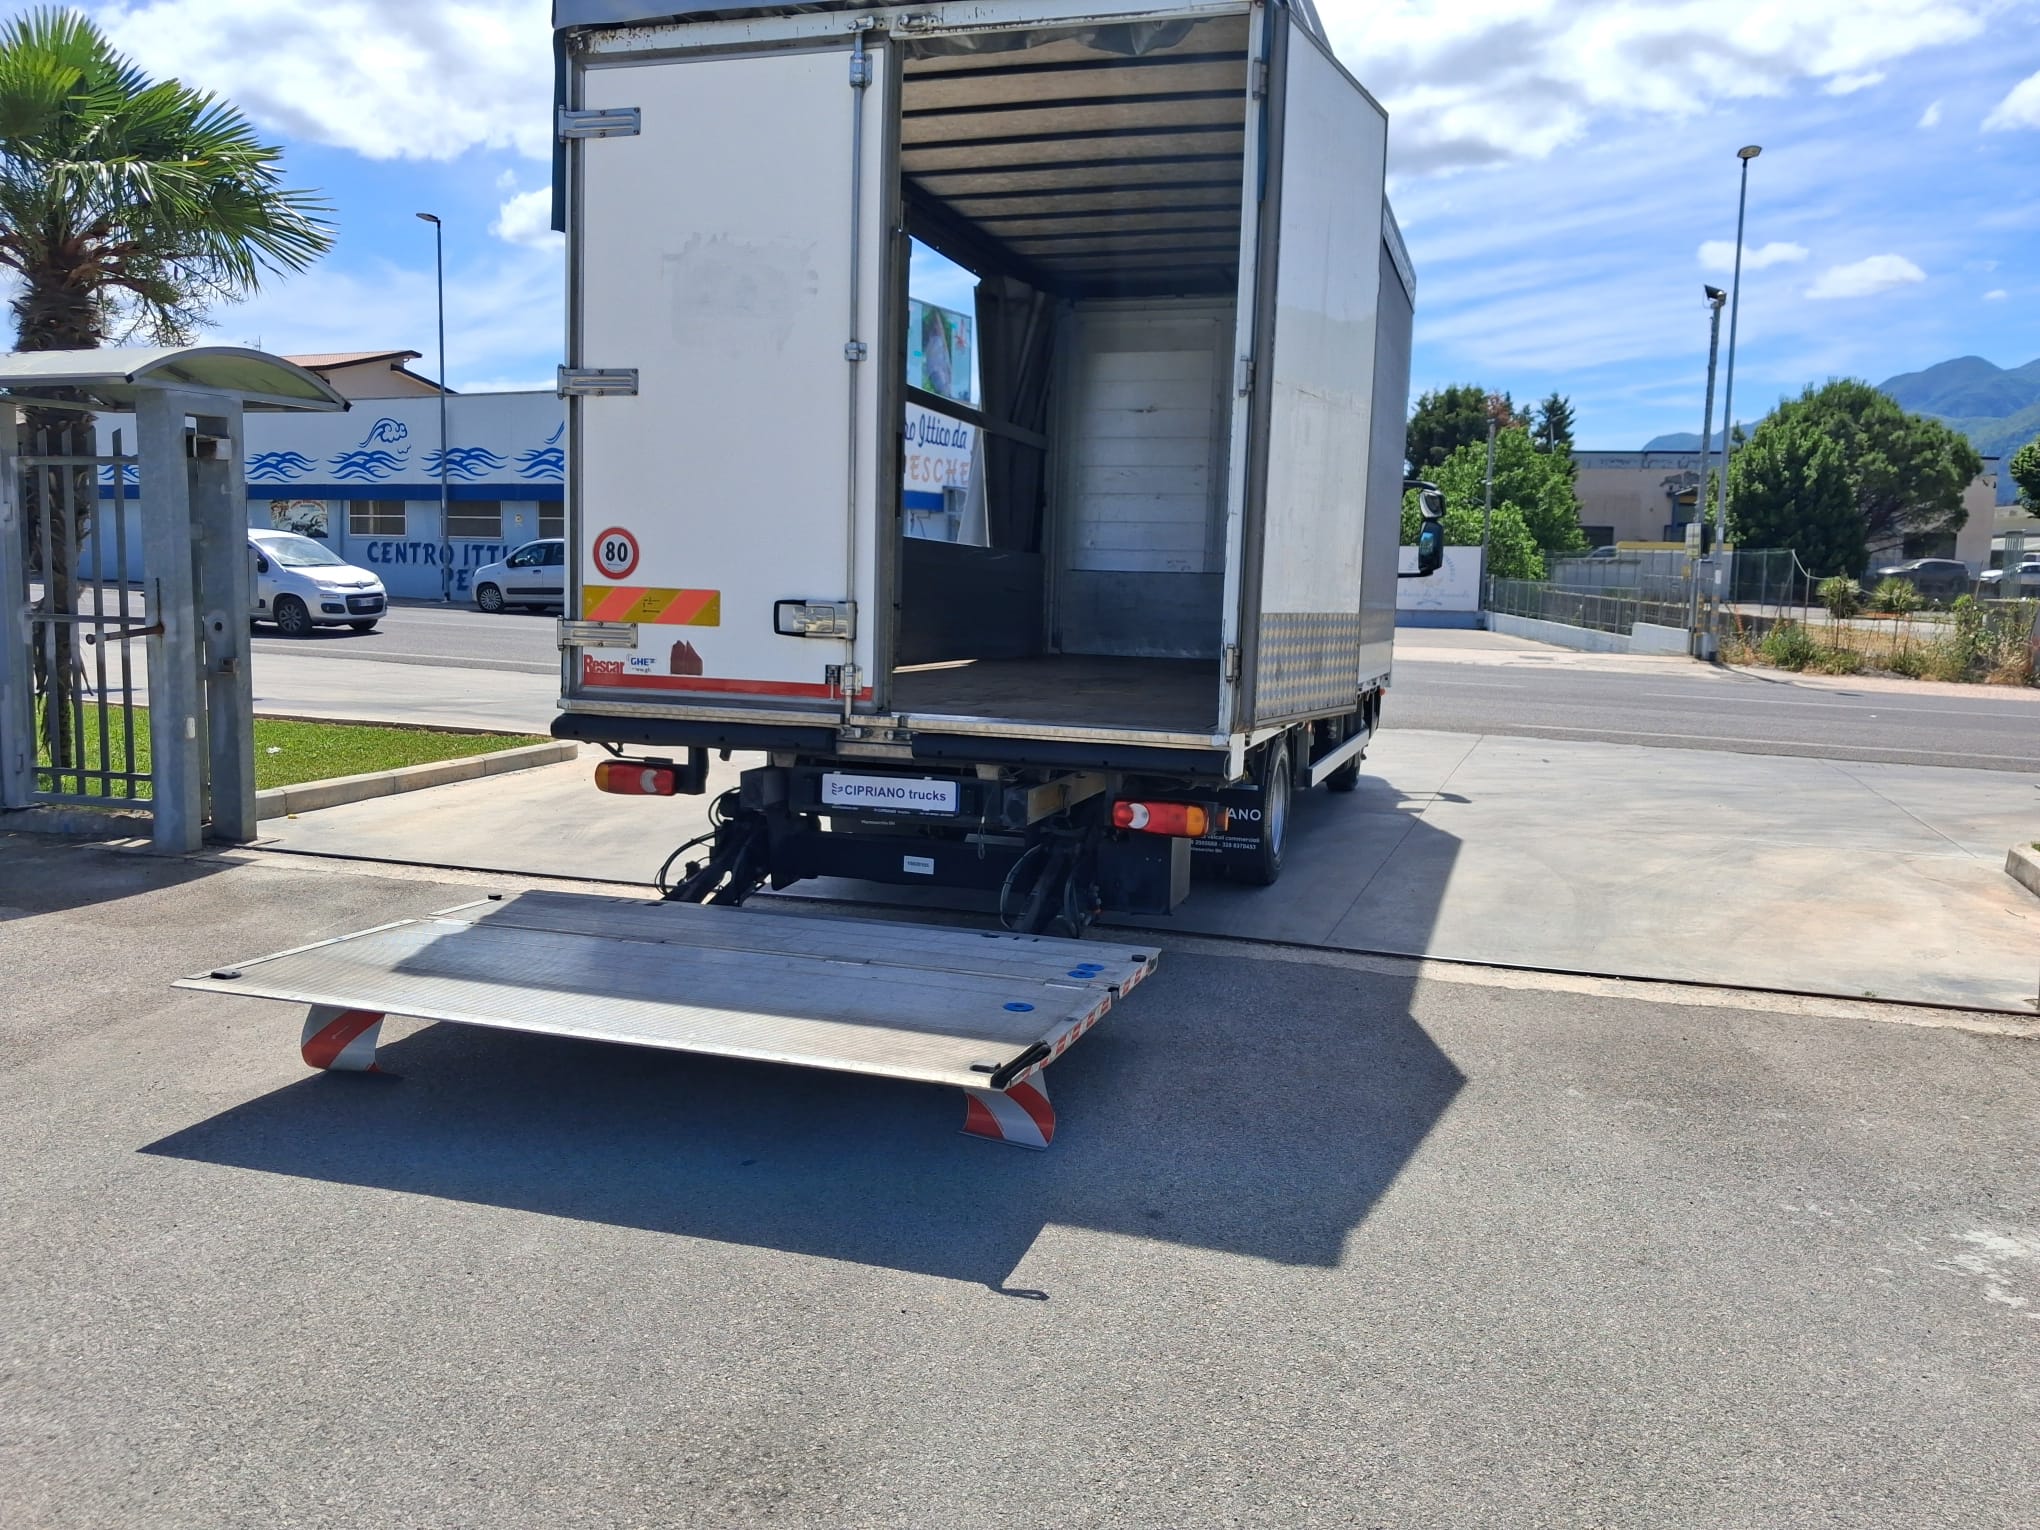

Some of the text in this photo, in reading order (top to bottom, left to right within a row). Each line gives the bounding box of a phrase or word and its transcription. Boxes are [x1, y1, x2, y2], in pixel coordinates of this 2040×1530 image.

[951, 421, 967, 449] da
[909, 455, 970, 486] ESCHE
[367, 541, 455, 566] CENTRO
[605, 541, 628, 562] 80
[583, 654, 624, 673] Rescar
[844, 784, 946, 801] CIPRIANO trucks
[1228, 807, 1261, 821] ANO
